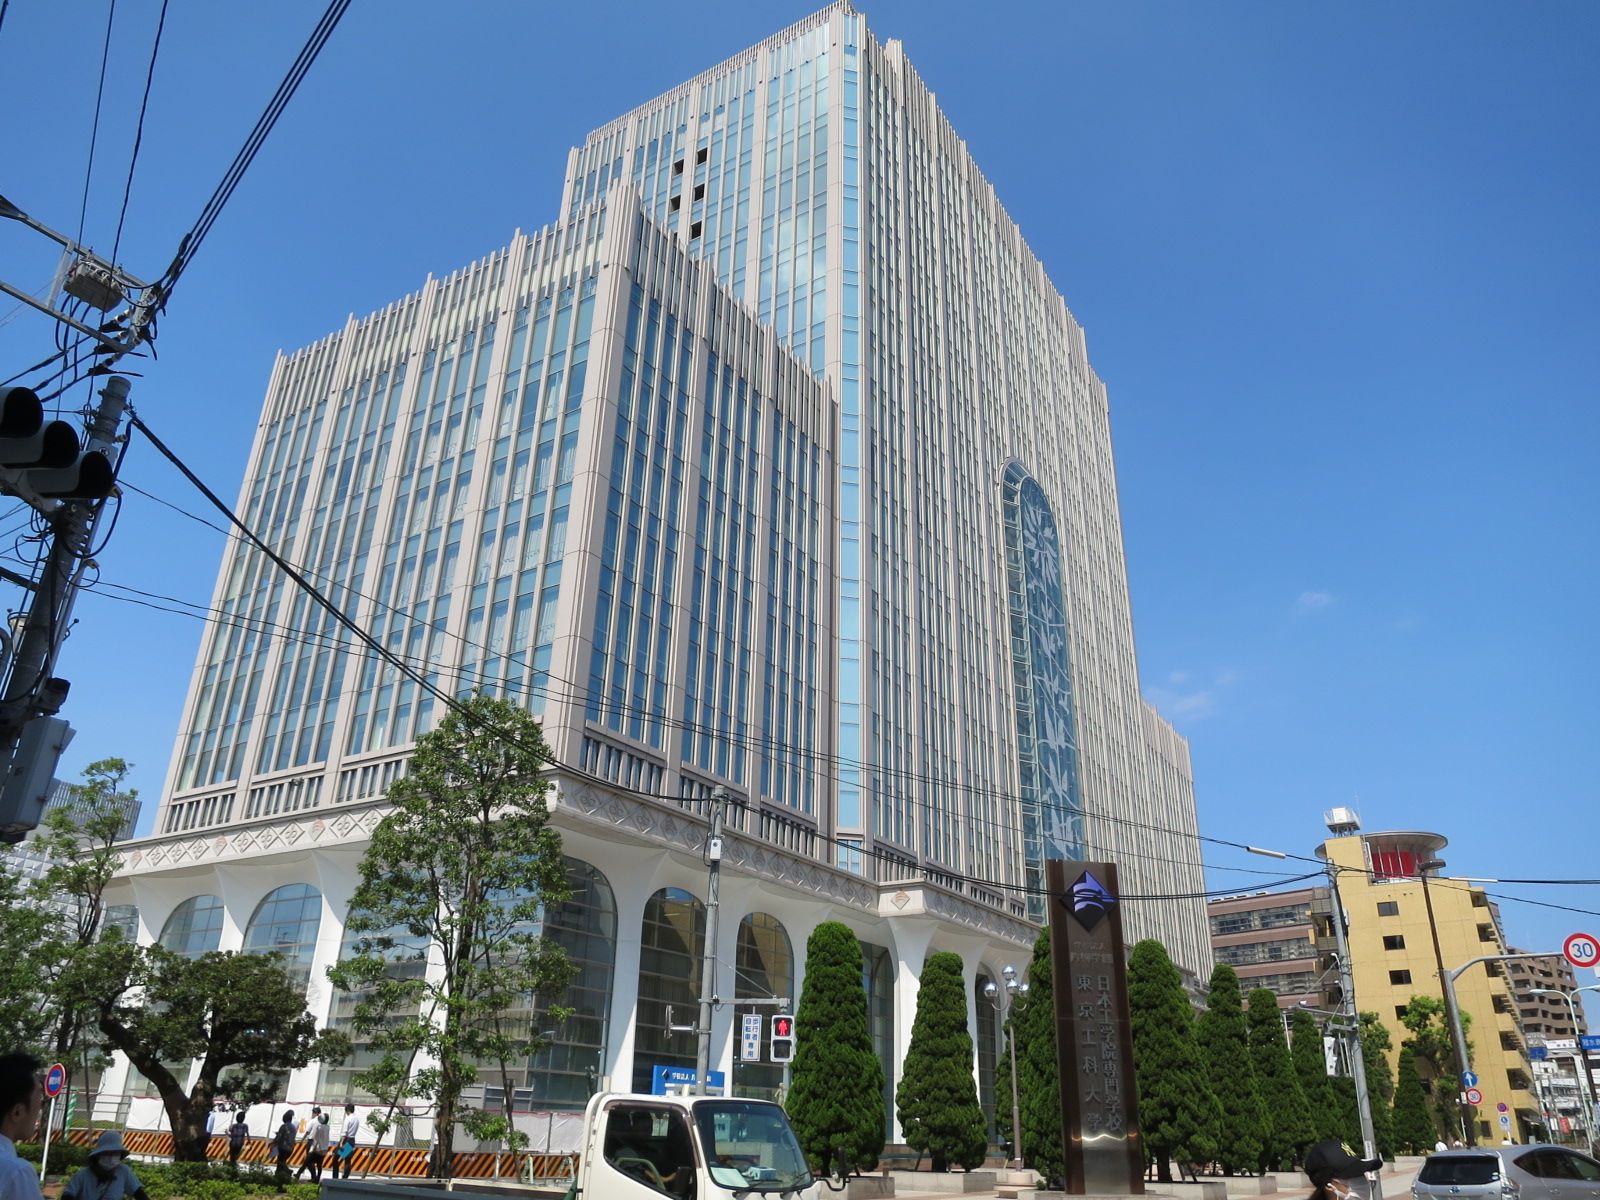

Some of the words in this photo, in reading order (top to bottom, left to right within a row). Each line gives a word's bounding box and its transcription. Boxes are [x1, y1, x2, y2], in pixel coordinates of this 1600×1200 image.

[1572, 943, 1593, 958] 30
[1078, 974, 1102, 1131] 東京工科大学
[1097, 976, 1122, 1131] 日本工学院専門学校
